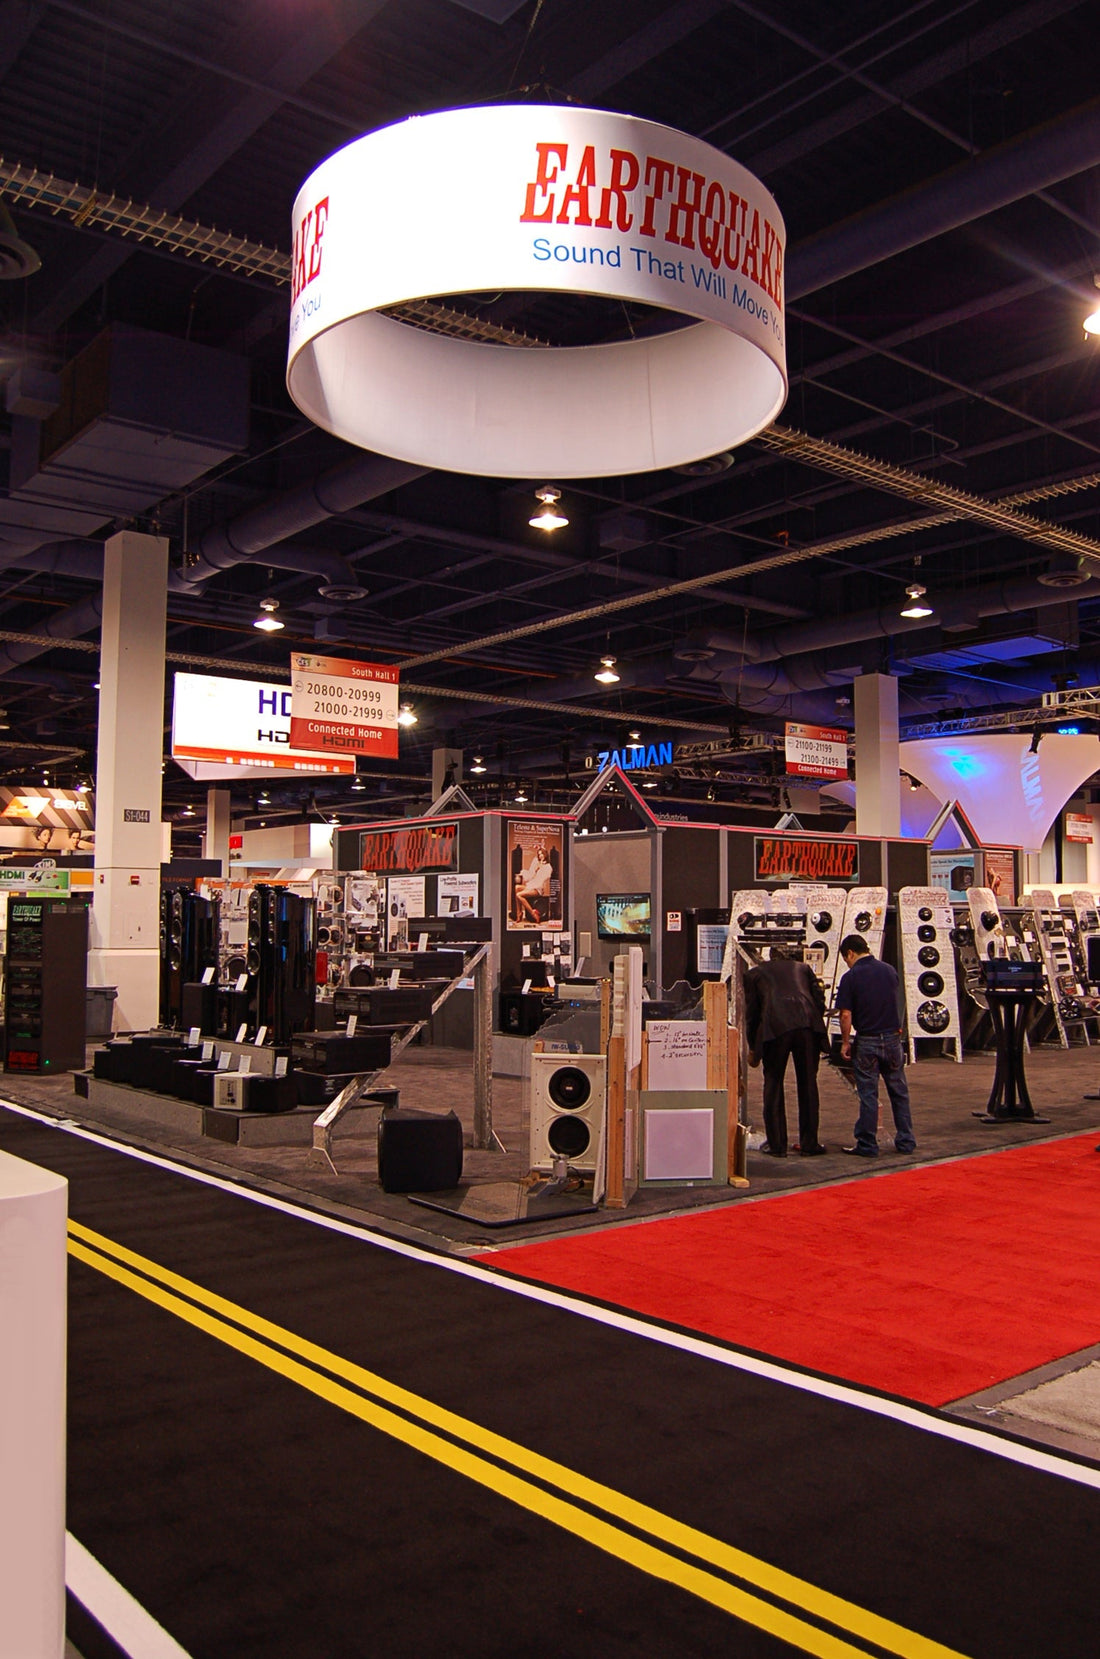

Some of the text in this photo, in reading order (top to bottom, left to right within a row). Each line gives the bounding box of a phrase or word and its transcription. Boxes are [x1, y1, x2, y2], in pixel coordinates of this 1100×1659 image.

[520, 143, 783, 312] EARTHQUAKE
[533, 238, 621, 268] Sound
[630, 247, 686, 283] That
[690, 264, 727, 299] Will
[732, 284, 769, 326] Move
[302, 293, 322, 321] You
[351, 667, 396, 681] South Hall 1
[307, 682, 381, 702] 20800-20999
[314, 701, 383, 720] 21000-21999
[308, 722, 383, 740] Connected Home
[597, 741, 672, 774] ZALMAN
[362, 825, 456, 873] EARTHQUAKE
[758, 839, 856, 880] EARTHQUAKE
[0, 870, 25, 880] HDMI
